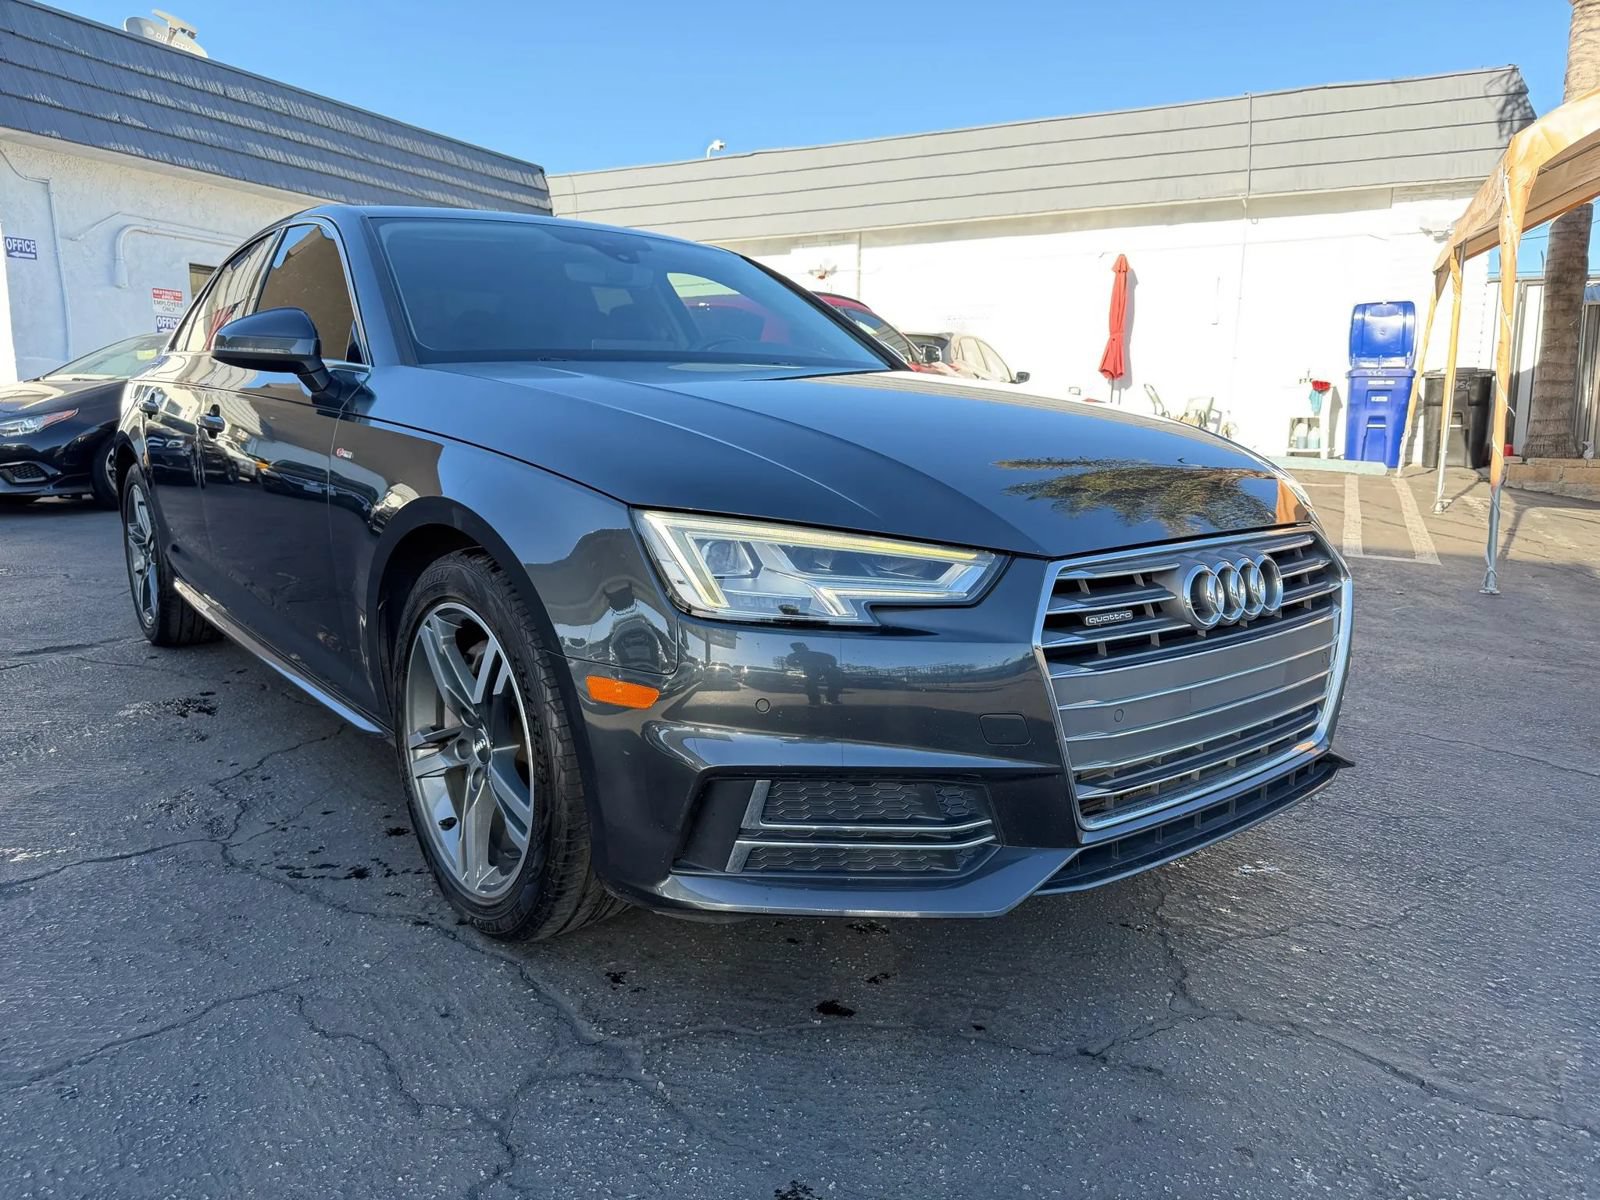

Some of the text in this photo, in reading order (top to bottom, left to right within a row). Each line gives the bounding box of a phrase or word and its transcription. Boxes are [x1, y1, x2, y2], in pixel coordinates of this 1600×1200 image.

[6, 238, 36, 253] OFFICE
[153, 299, 183, 308] EMPLOYEES
[1088, 612, 1132, 624] quattro
